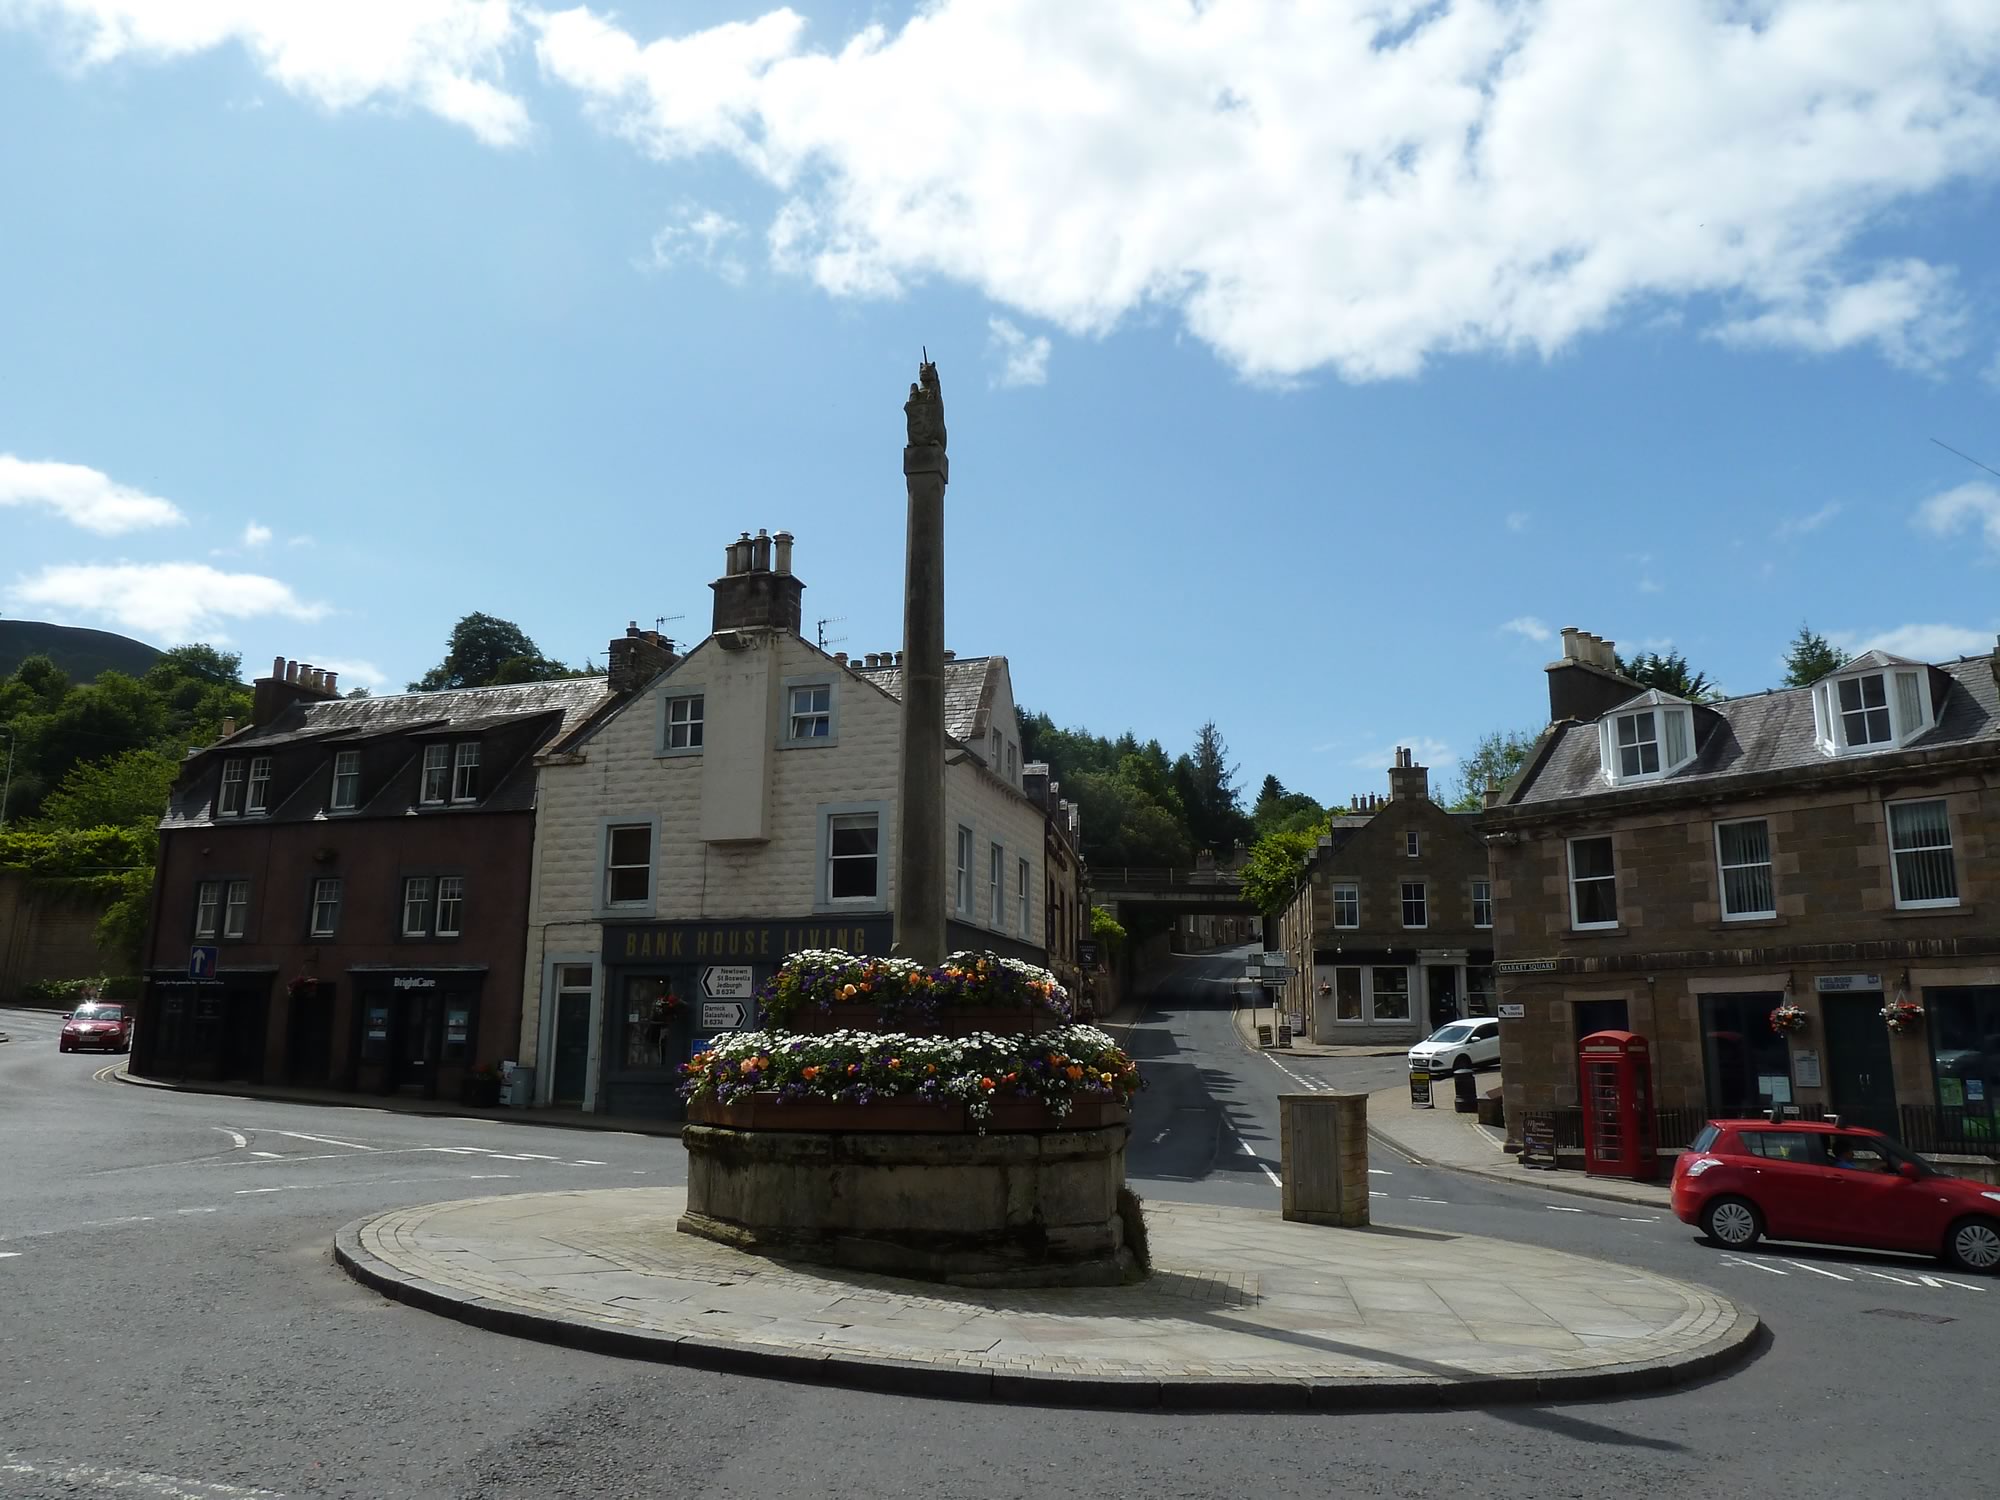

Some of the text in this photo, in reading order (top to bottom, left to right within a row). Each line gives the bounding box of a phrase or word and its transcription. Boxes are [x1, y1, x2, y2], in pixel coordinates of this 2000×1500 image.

[625, 927, 866, 956] BANK HOUSE LIVING
[394, 977, 436, 989] BrightCare
